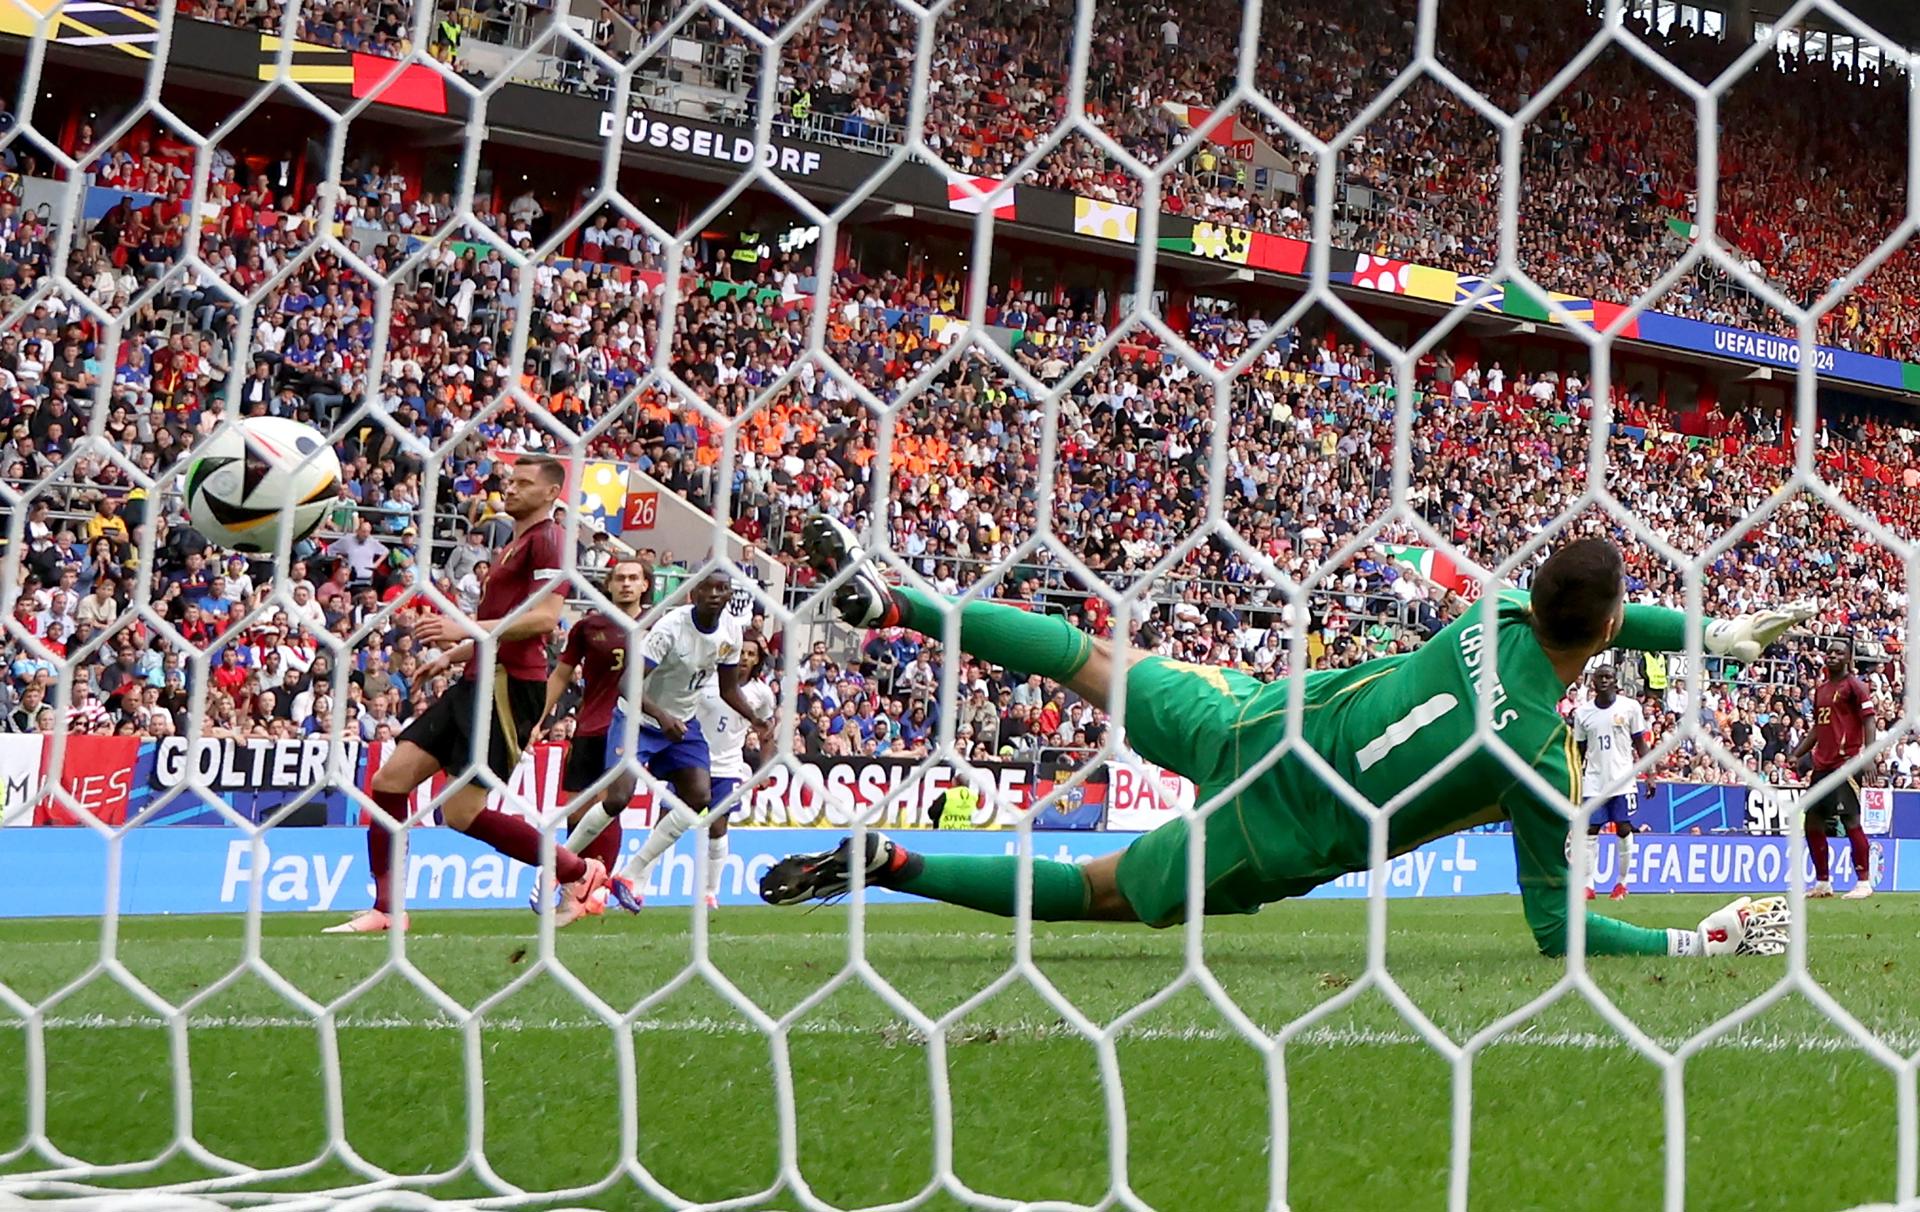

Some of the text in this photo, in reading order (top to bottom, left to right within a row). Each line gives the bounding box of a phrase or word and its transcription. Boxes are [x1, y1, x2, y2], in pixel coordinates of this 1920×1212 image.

[599, 110, 821, 175] DÜSSELDORF
[631, 498, 656, 525] 26
[1462, 579, 1481, 600] 28
[610, 647, 626, 671] 3
[688, 668, 707, 690] 12
[716, 716, 729, 733] 5
[1817, 706, 1831, 724] 22
[1355, 692, 1459, 773] 1
[1598, 734, 1611, 751] 13
[156, 736, 359, 788] GOLTERN
[728, 762, 1026, 827] ROSSHEDE
[1625, 793, 1638, 810] 13
[220, 839, 354, 912] Pay
[366, 852, 545, 900] mar
